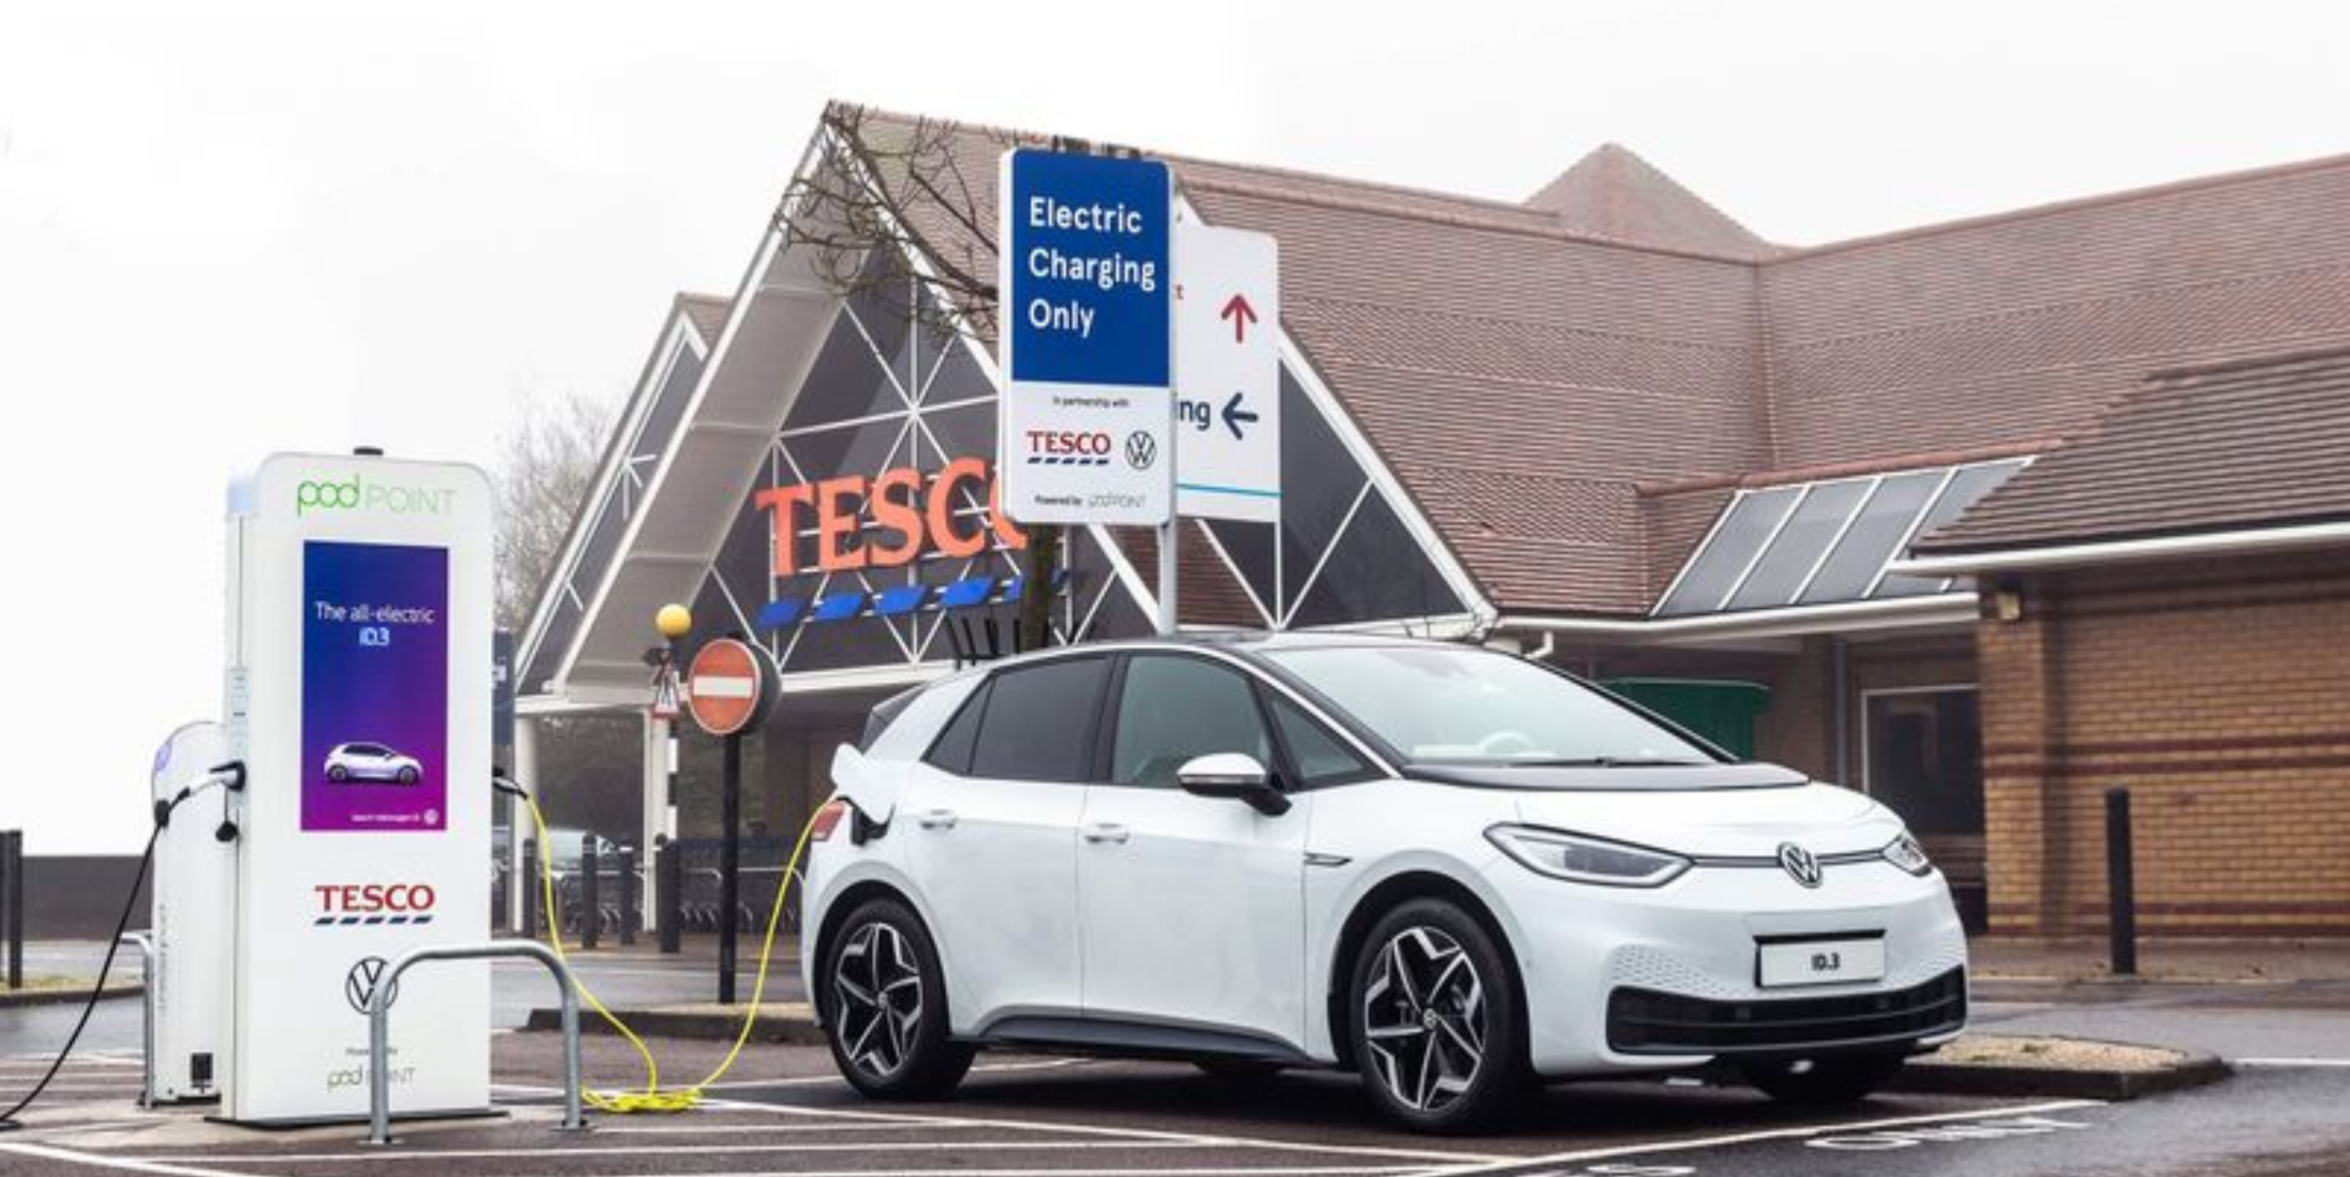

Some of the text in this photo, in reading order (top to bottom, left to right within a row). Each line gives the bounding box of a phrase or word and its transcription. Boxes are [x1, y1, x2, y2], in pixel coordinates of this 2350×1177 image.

[1029, 196, 1143, 234] Electric
[1029, 247, 1156, 292] Charging
[1029, 298, 1095, 338] Only
[1026, 430, 1112, 455] TESCO
[297, 472, 458, 518] pod POINT
[314, 601, 436, 624] The all-electric
[314, 884, 436, 913] TESCO
[1811, 952, 1841, 972] ID.3
